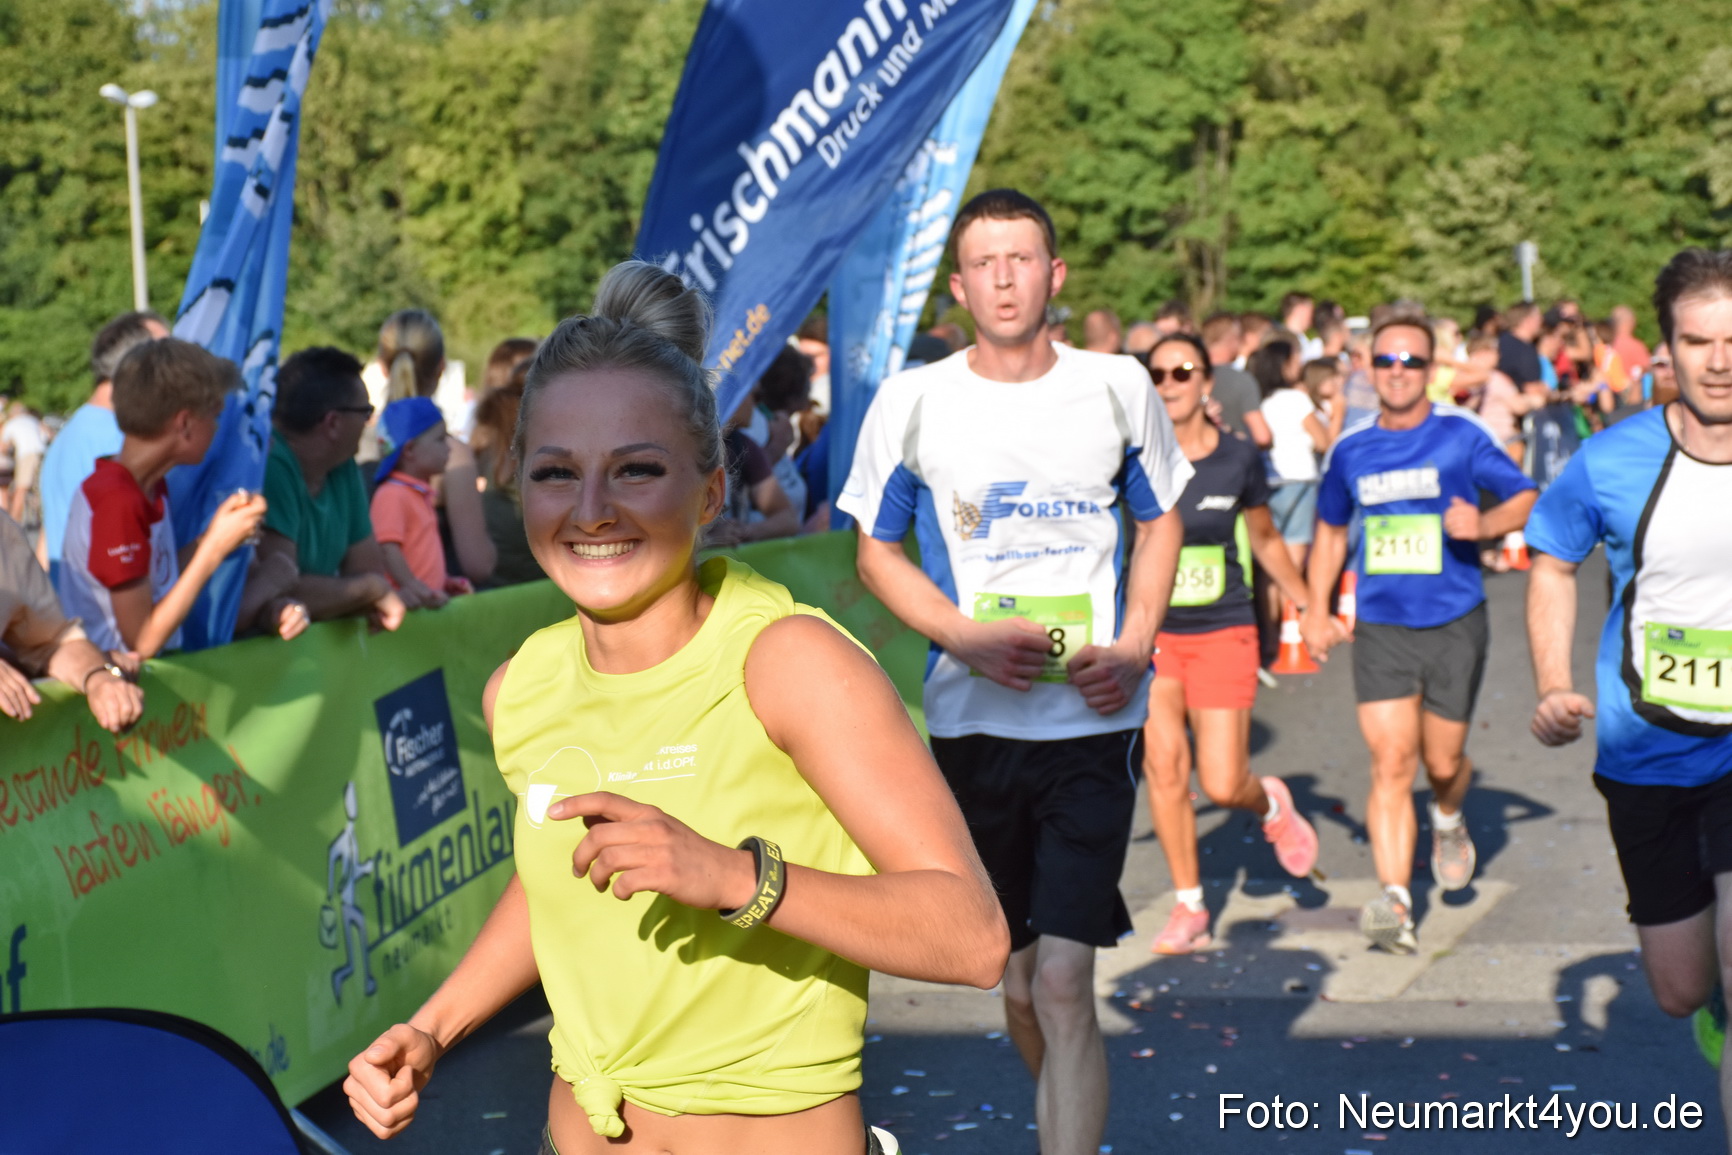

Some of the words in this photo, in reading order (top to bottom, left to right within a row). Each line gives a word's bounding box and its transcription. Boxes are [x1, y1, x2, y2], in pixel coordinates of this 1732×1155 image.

[815, 82, 883, 170] Druck
[876, 19, 924, 88] und
[918, 0, 954, 31] M
[1374, 536, 1428, 557] 2110
[1658, 654, 1732, 689] 211
[656, 743, 698, 756] kreises
[0, 723, 107, 834] esunde
